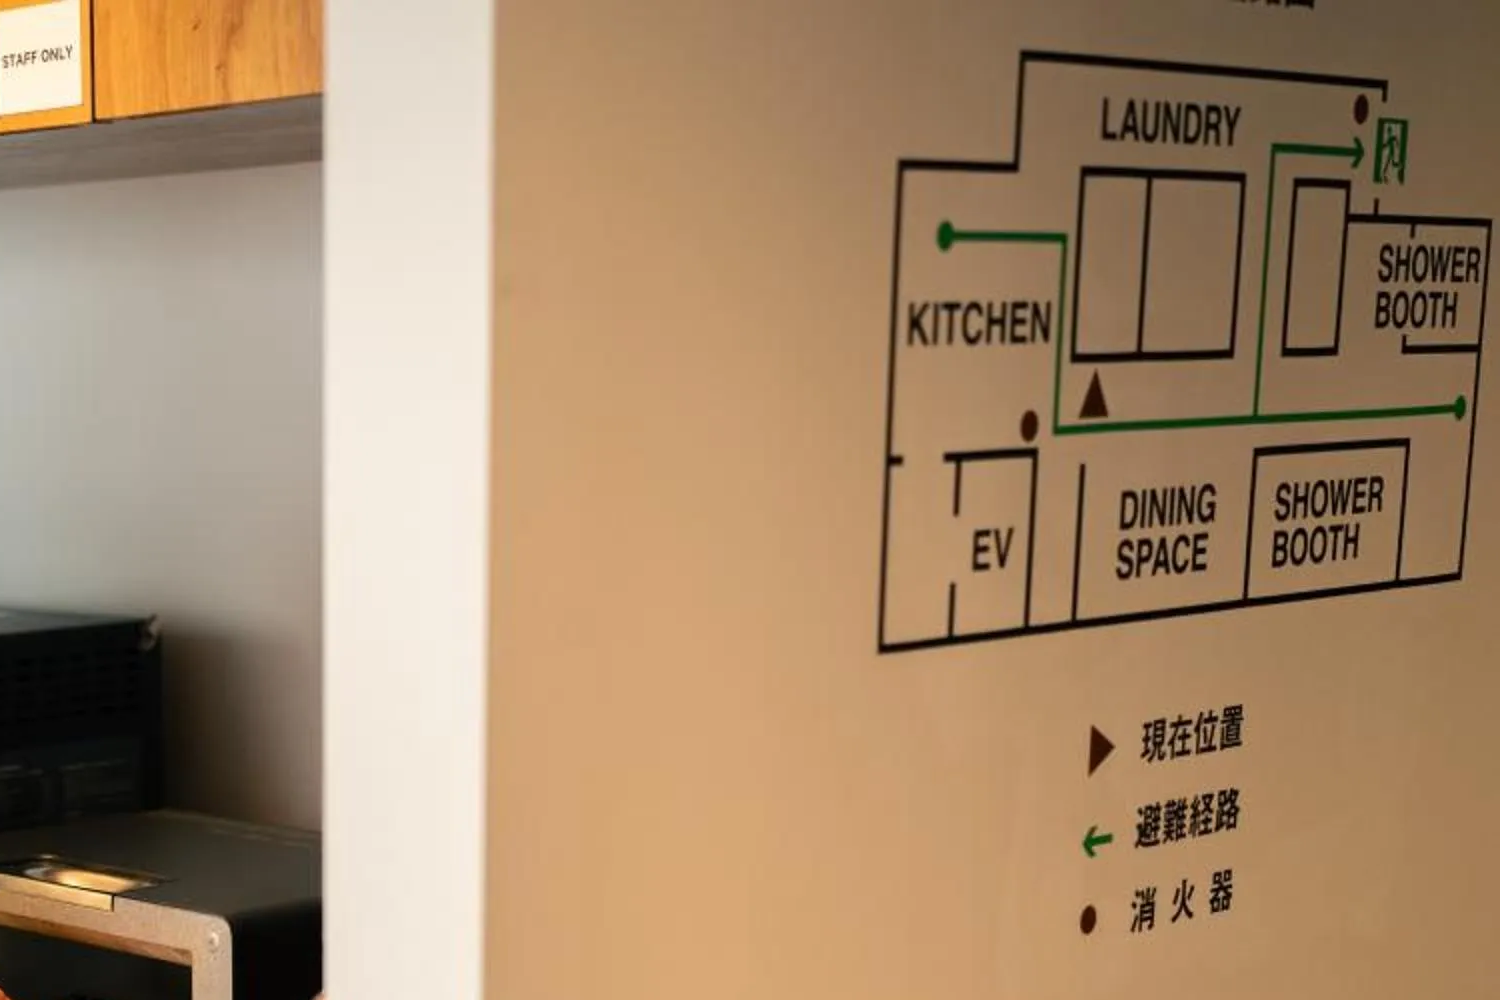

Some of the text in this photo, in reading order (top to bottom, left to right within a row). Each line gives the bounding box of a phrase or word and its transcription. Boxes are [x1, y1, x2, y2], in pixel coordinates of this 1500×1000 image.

[1, 44, 73, 69] STAFF ONLY
[1101, 97, 1242, 147] LAUNDRY
[1378, 244, 1482, 285] SHOWER
[906, 300, 1052, 346] KITCHEN
[1374, 290, 1459, 330] BOOTH
[1119, 482, 1217, 531] DINING
[1274, 475, 1385, 522] SHOWER
[971, 527, 1015, 573] EV
[1115, 531, 1210, 581] SPACE
[1271, 522, 1361, 569] BOOTH
[1140, 704, 1245, 764] 現在位置
[1134, 787, 1241, 849] 避難経路
[1130, 868, 1233, 933] 消火器
